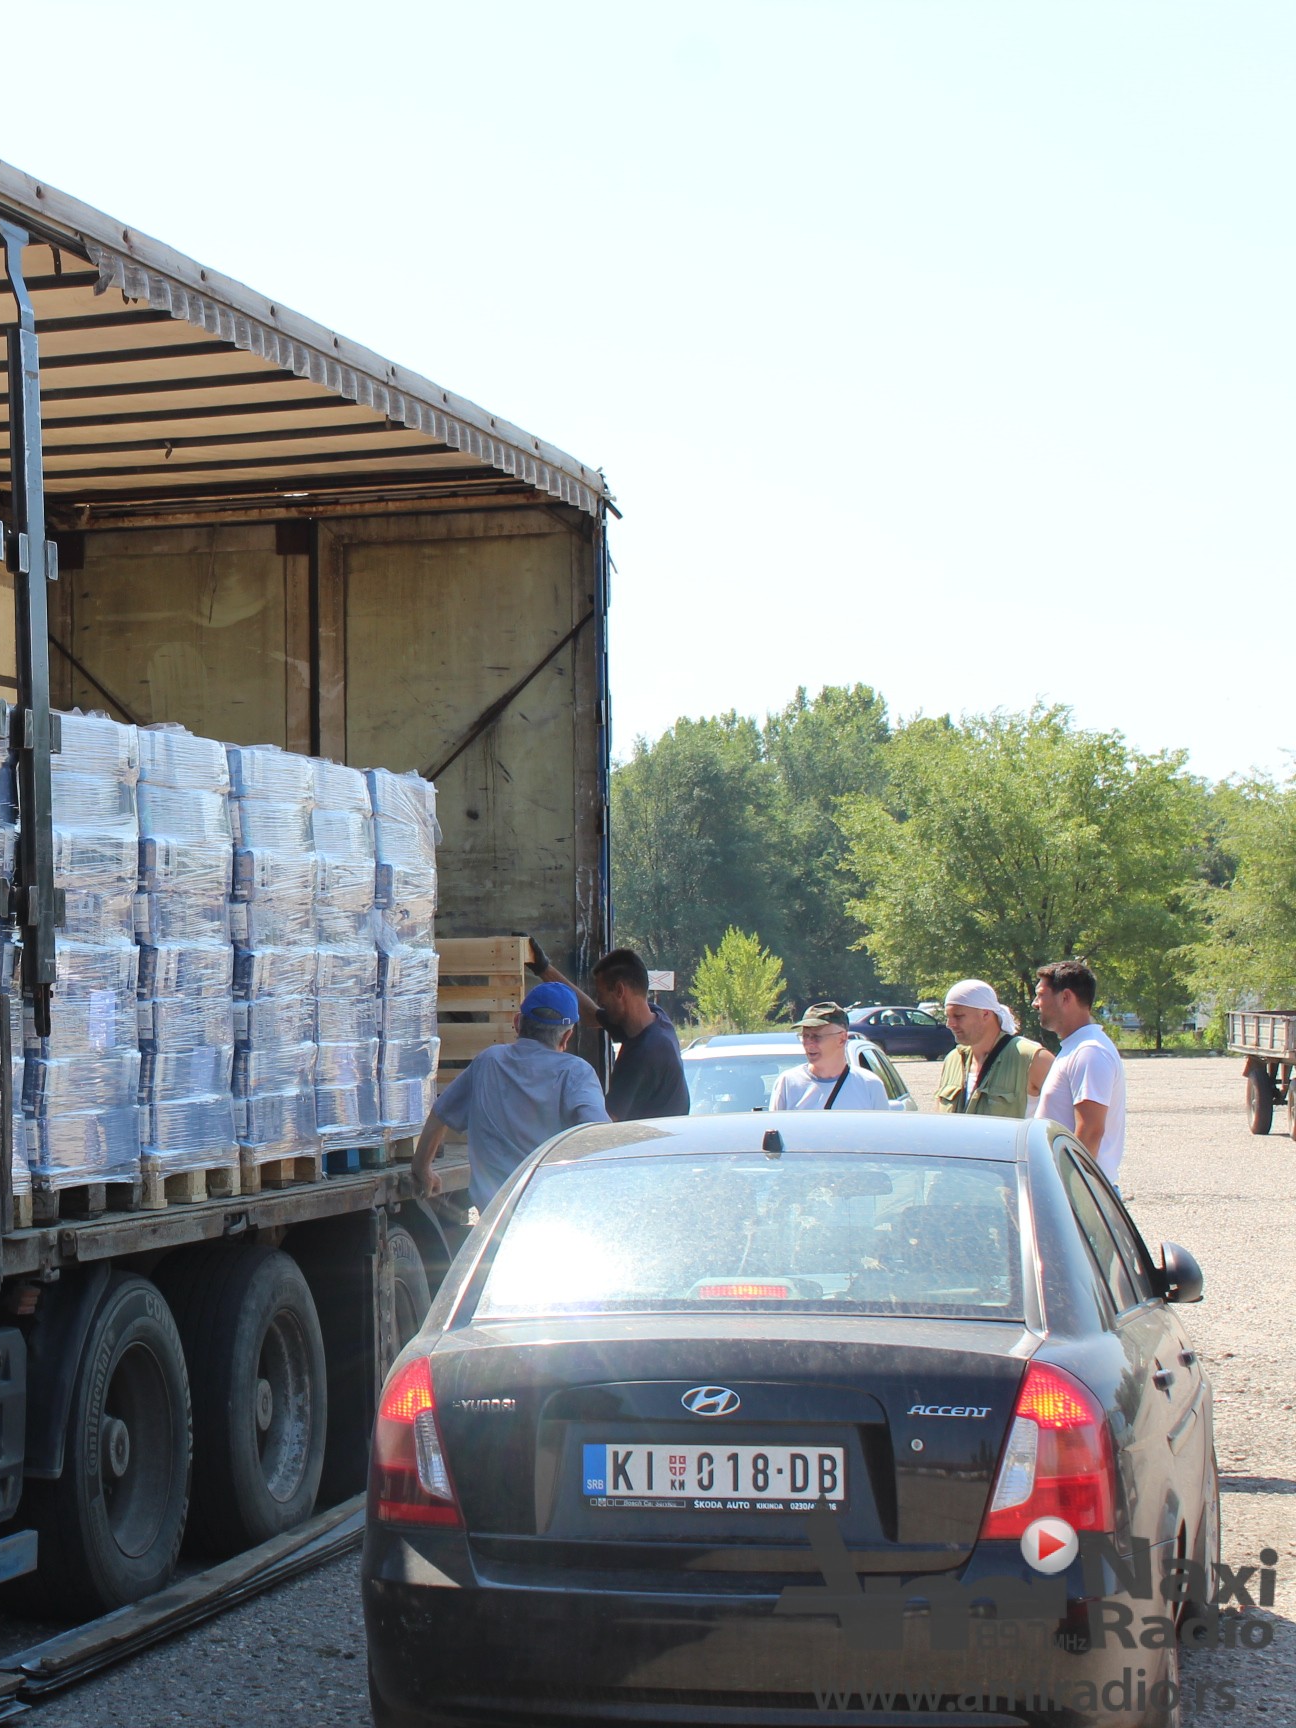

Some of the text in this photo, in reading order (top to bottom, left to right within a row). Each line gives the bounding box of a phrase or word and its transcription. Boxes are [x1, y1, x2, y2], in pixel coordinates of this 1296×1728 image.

[906, 1404, 992, 1418] ACCENT
[612, 1450, 653, 1491] KI
[587, 1478, 604, 1490] SRB
[694, 1500, 723, 1509] ŠKODA
[726, 1501, 750, 1509] AUTO
[756, 1502, 784, 1510] KIKINDA
